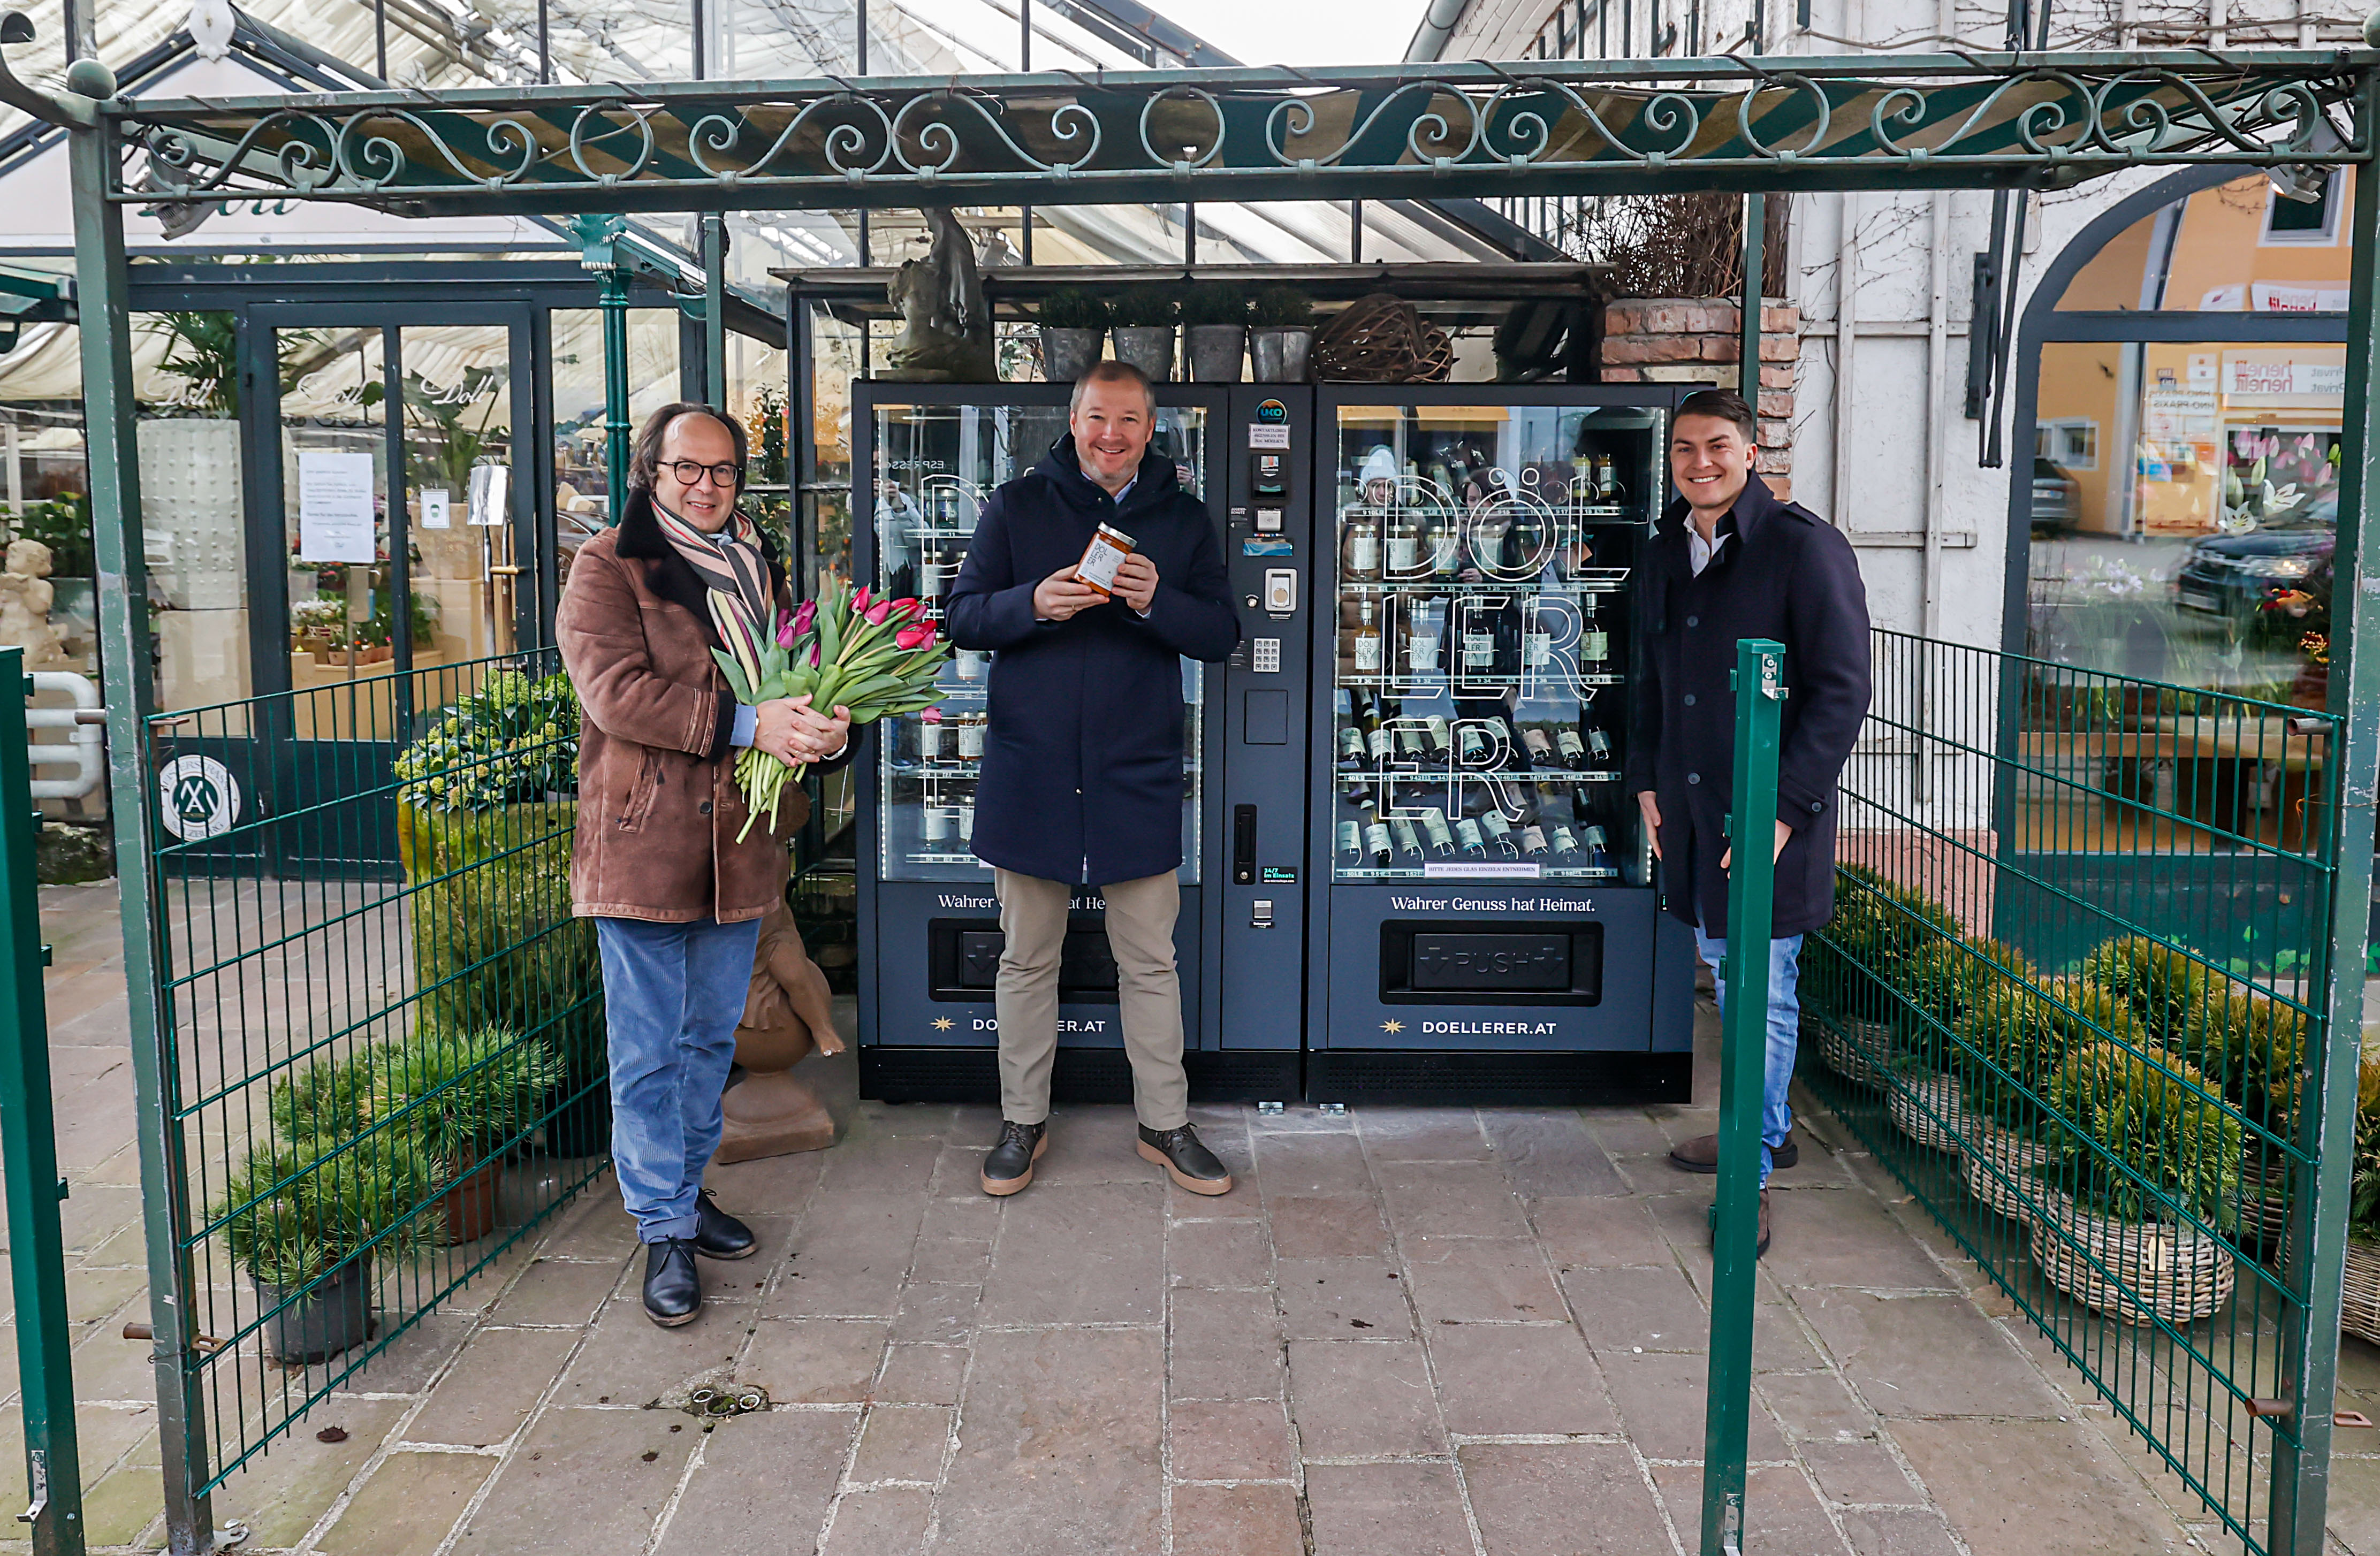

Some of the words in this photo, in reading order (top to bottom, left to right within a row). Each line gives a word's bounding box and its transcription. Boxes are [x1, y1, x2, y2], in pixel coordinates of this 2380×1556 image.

[420, 375, 493, 404] Doll
[1091, 550, 1104, 562] LER
[1094, 543, 1108, 556] DÖL
[1087, 557, 1096, 567] ER
[1381, 593, 1597, 701] LER
[1379, 718, 1524, 822] ER
[938, 895, 994, 908] Wahrer
[1391, 897, 1448, 910] Wahrer
[1452, 897, 1507, 911] Genuss
[1512, 897, 1535, 911] hat
[1540, 898, 1595, 912] Heimat.
[1455, 952, 1530, 973] PUSH
[1422, 1021, 1557, 1034] DOELLERER.AT
